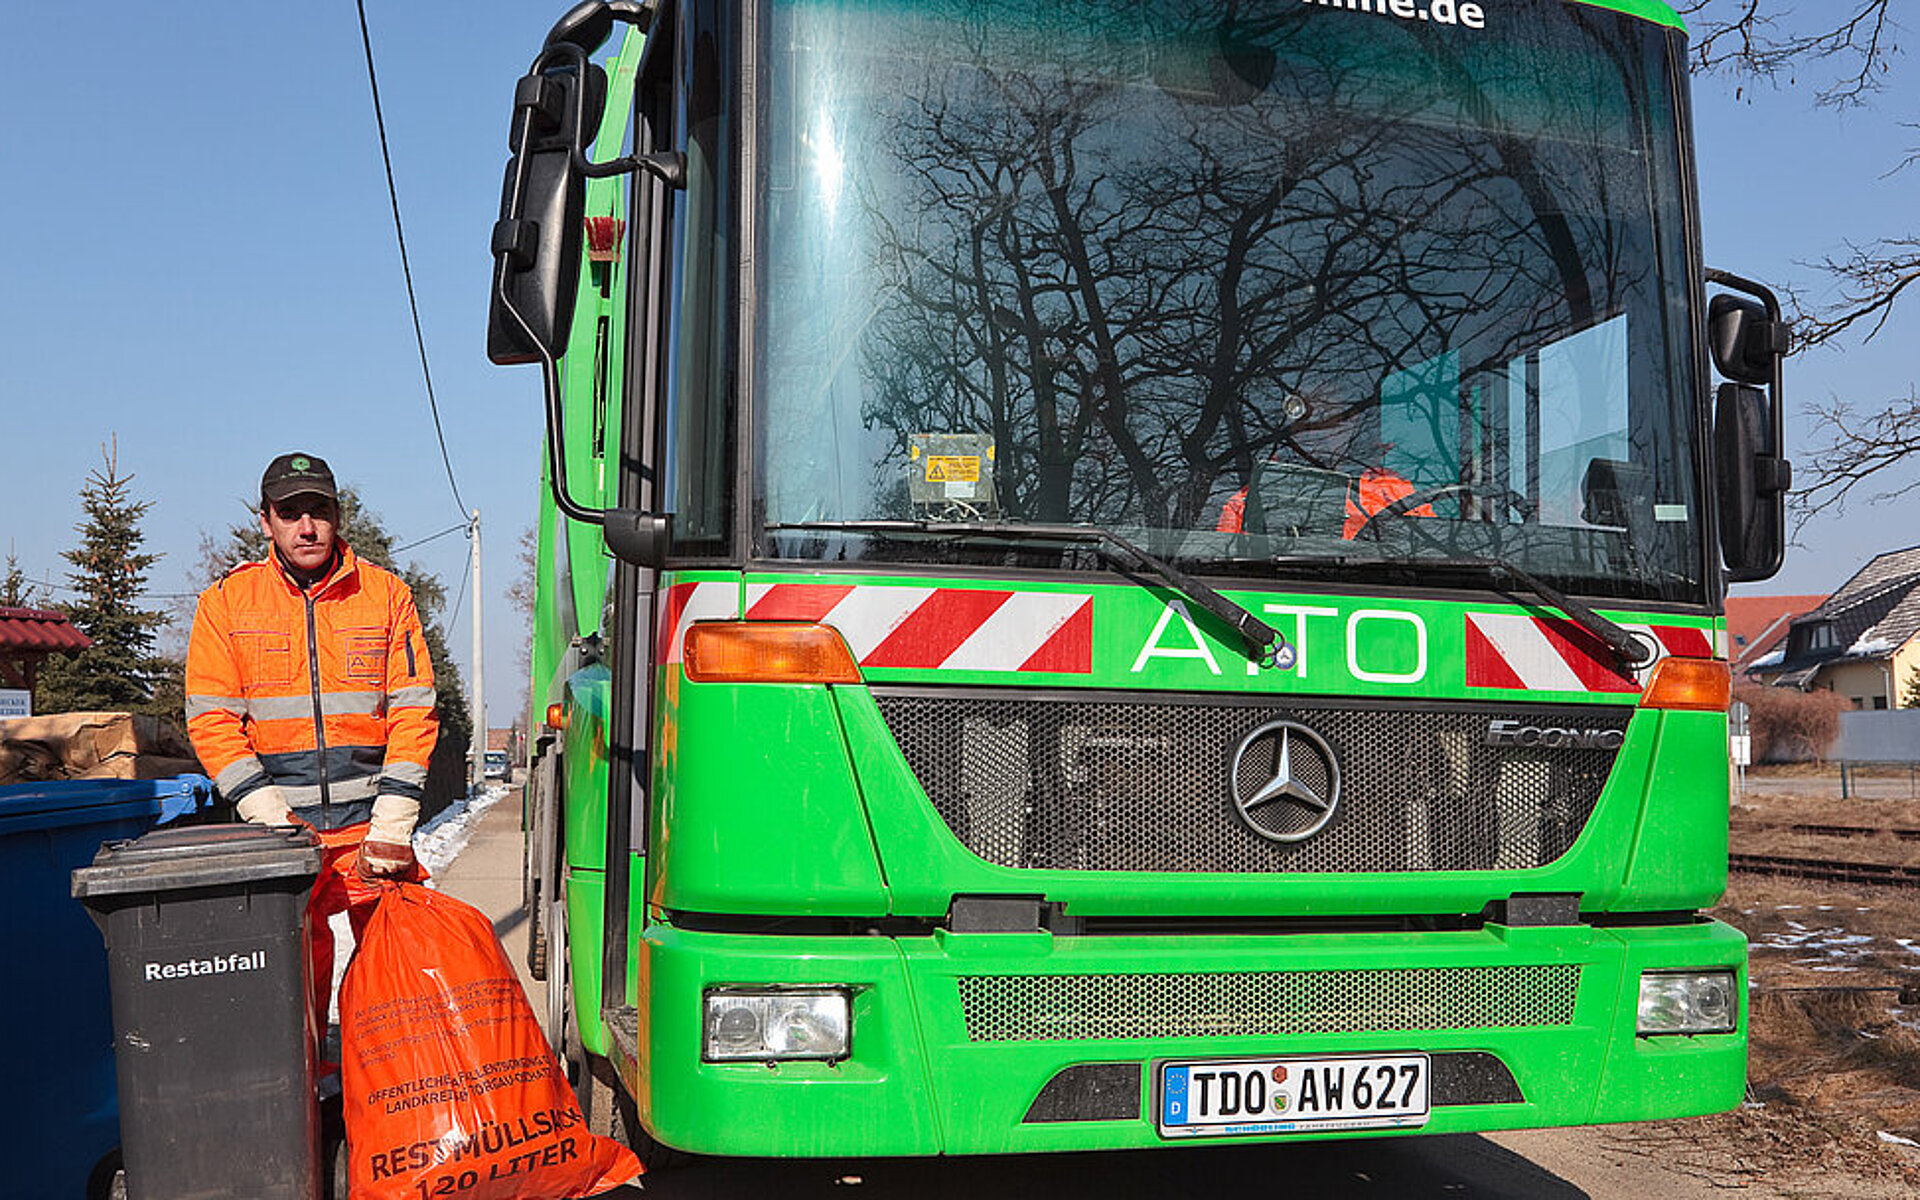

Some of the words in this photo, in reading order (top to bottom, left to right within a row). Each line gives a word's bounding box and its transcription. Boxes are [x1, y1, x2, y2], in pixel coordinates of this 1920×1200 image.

[145, 950, 266, 981] Restabfall
[368, 1073, 450, 1106] ÖFFENTLICHE
[1193, 1070, 1266, 1116] TDO
[1298, 1066, 1345, 1112] AW
[1353, 1064, 1420, 1110] 627
[1171, 1101, 1181, 1115] D
[416, 1170, 479, 1200] 120
[490, 1137, 578, 1181] LITER
